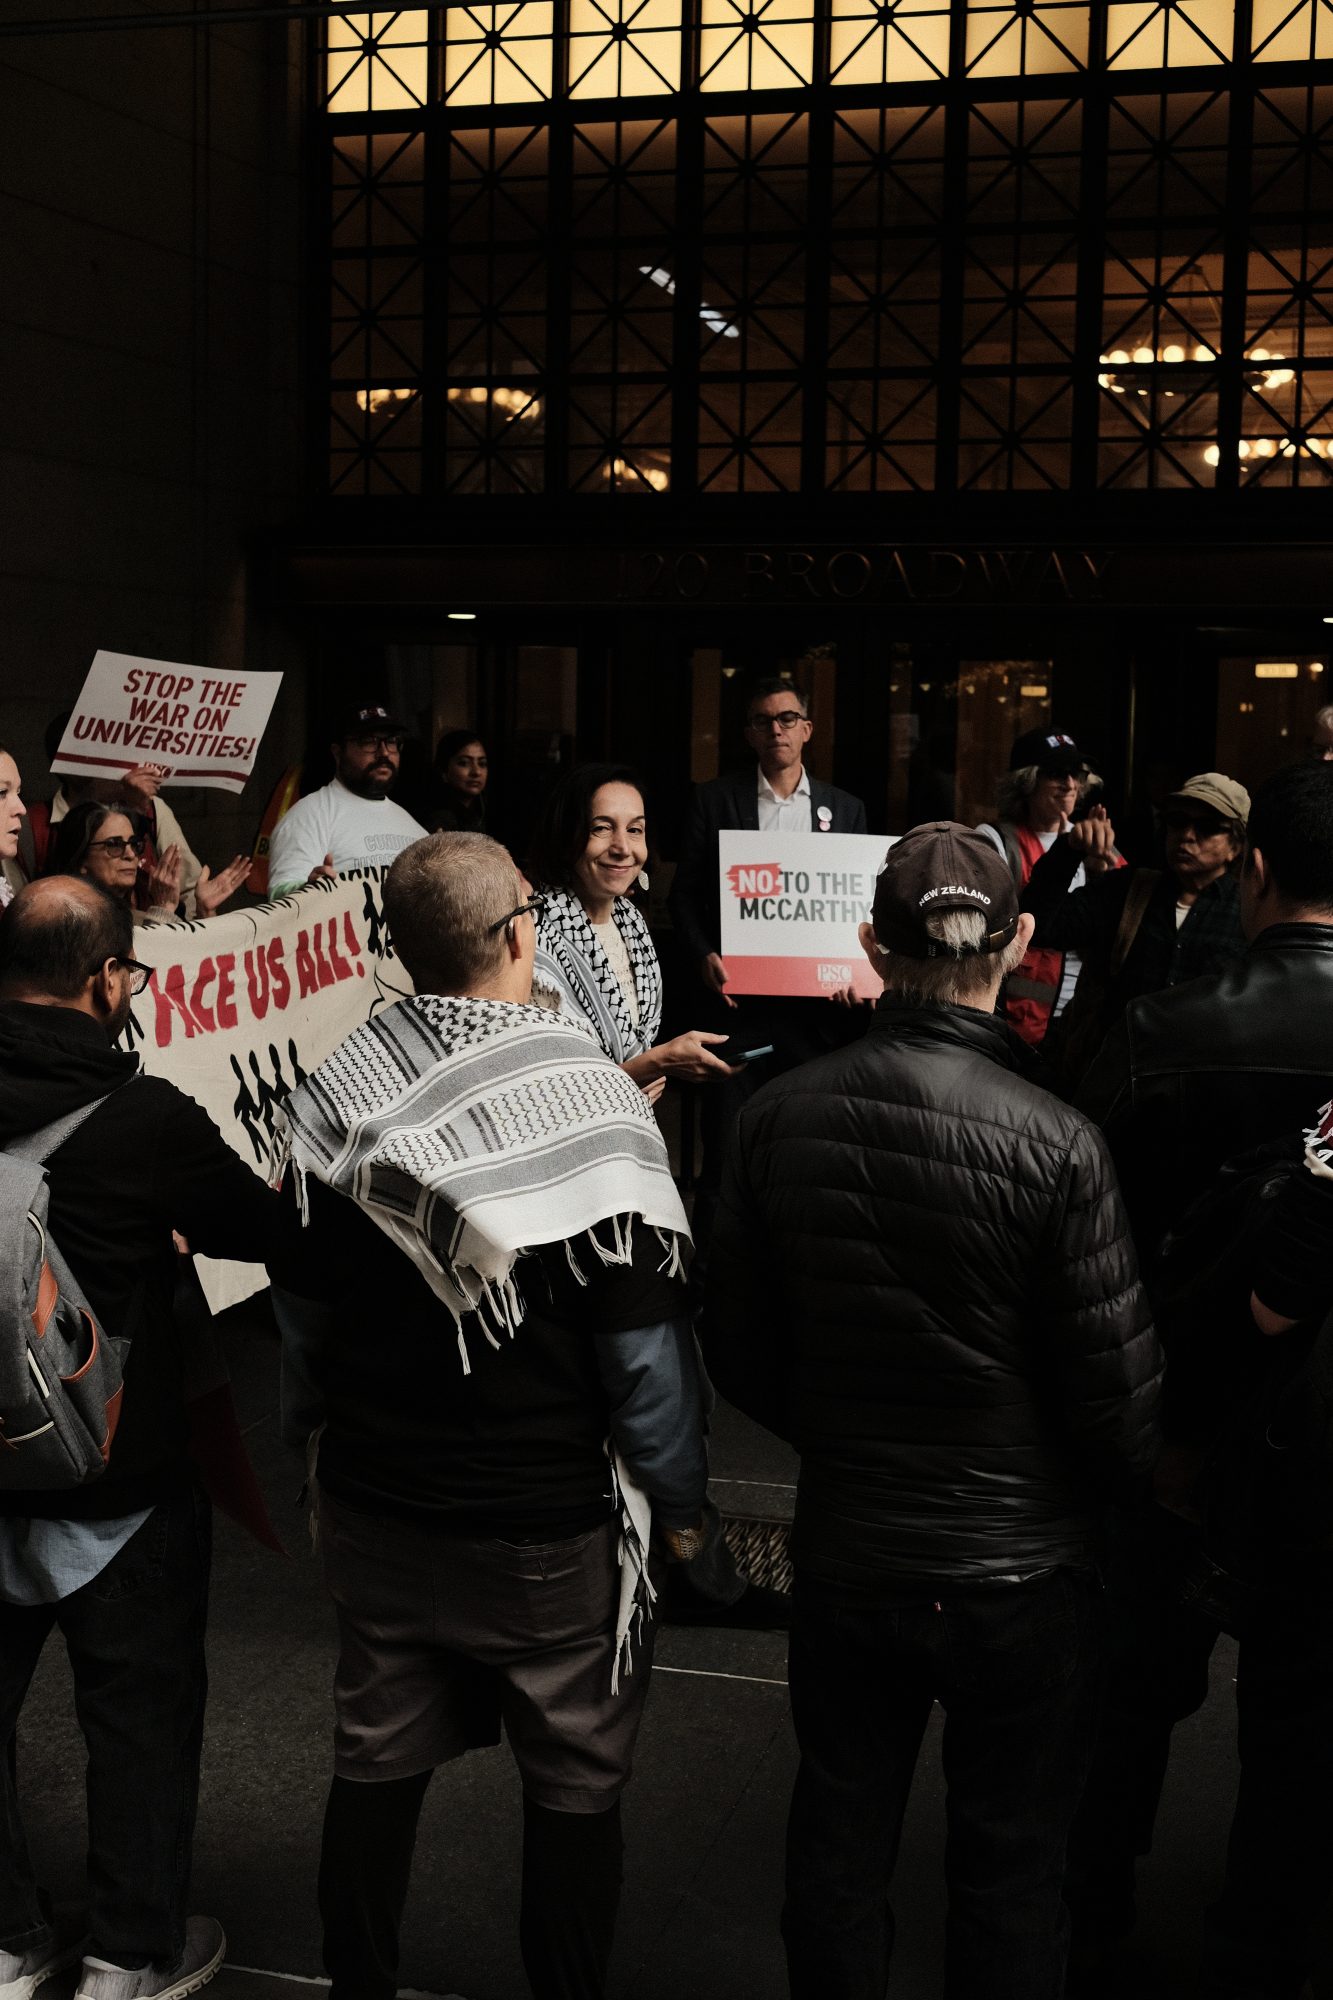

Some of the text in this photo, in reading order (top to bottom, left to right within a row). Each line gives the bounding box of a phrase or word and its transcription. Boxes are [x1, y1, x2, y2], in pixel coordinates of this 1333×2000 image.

[742, 550, 1116, 600] BROADWAY
[123, 668, 247, 707] STOP THE
[129, 697, 230, 732] WAR ON
[73, 715, 256, 760] UNIVERSITIES!
[738, 869, 773, 894] NO
[780, 871, 810, 894] TO
[816, 872, 863, 896] THE
[918, 886, 991, 907] NEW ZEALAND
[244, 936, 290, 1020] US
[296, 911, 365, 999] ALL!
[820, 964, 850, 981] PSC
